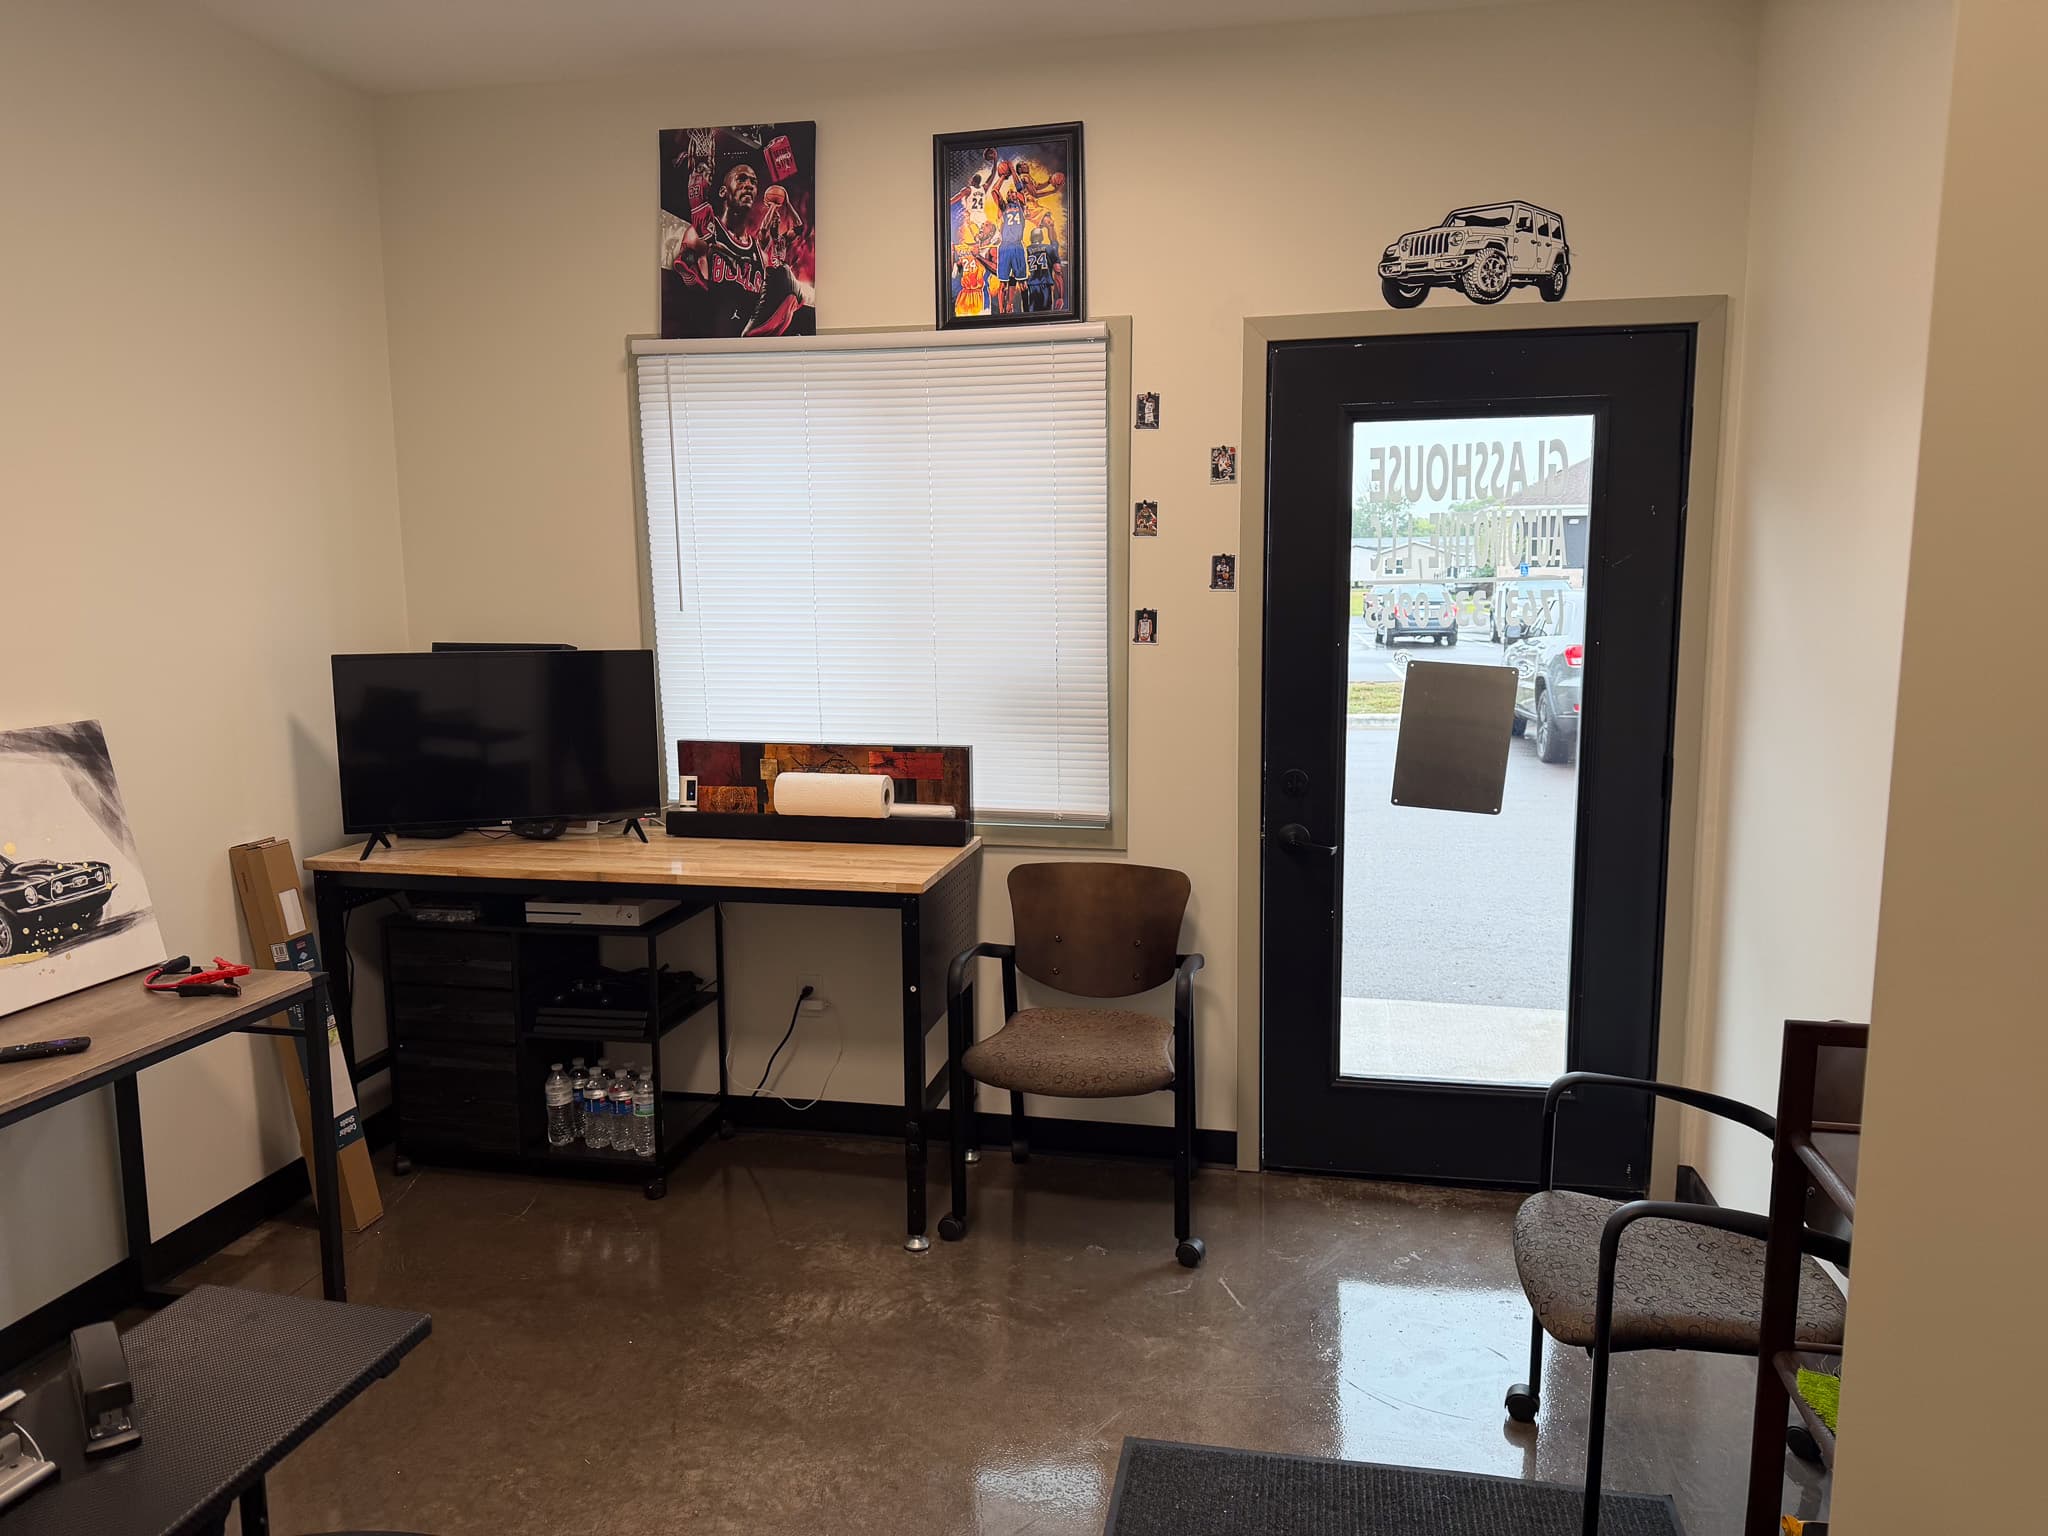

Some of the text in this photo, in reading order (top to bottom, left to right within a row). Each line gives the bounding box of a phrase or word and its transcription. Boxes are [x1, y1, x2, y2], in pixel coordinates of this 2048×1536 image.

[971, 198, 984, 209] 24
[1007, 212, 1021, 226] 24
[962, 258, 977, 272] 24
[1027, 252, 1048, 271] 24
